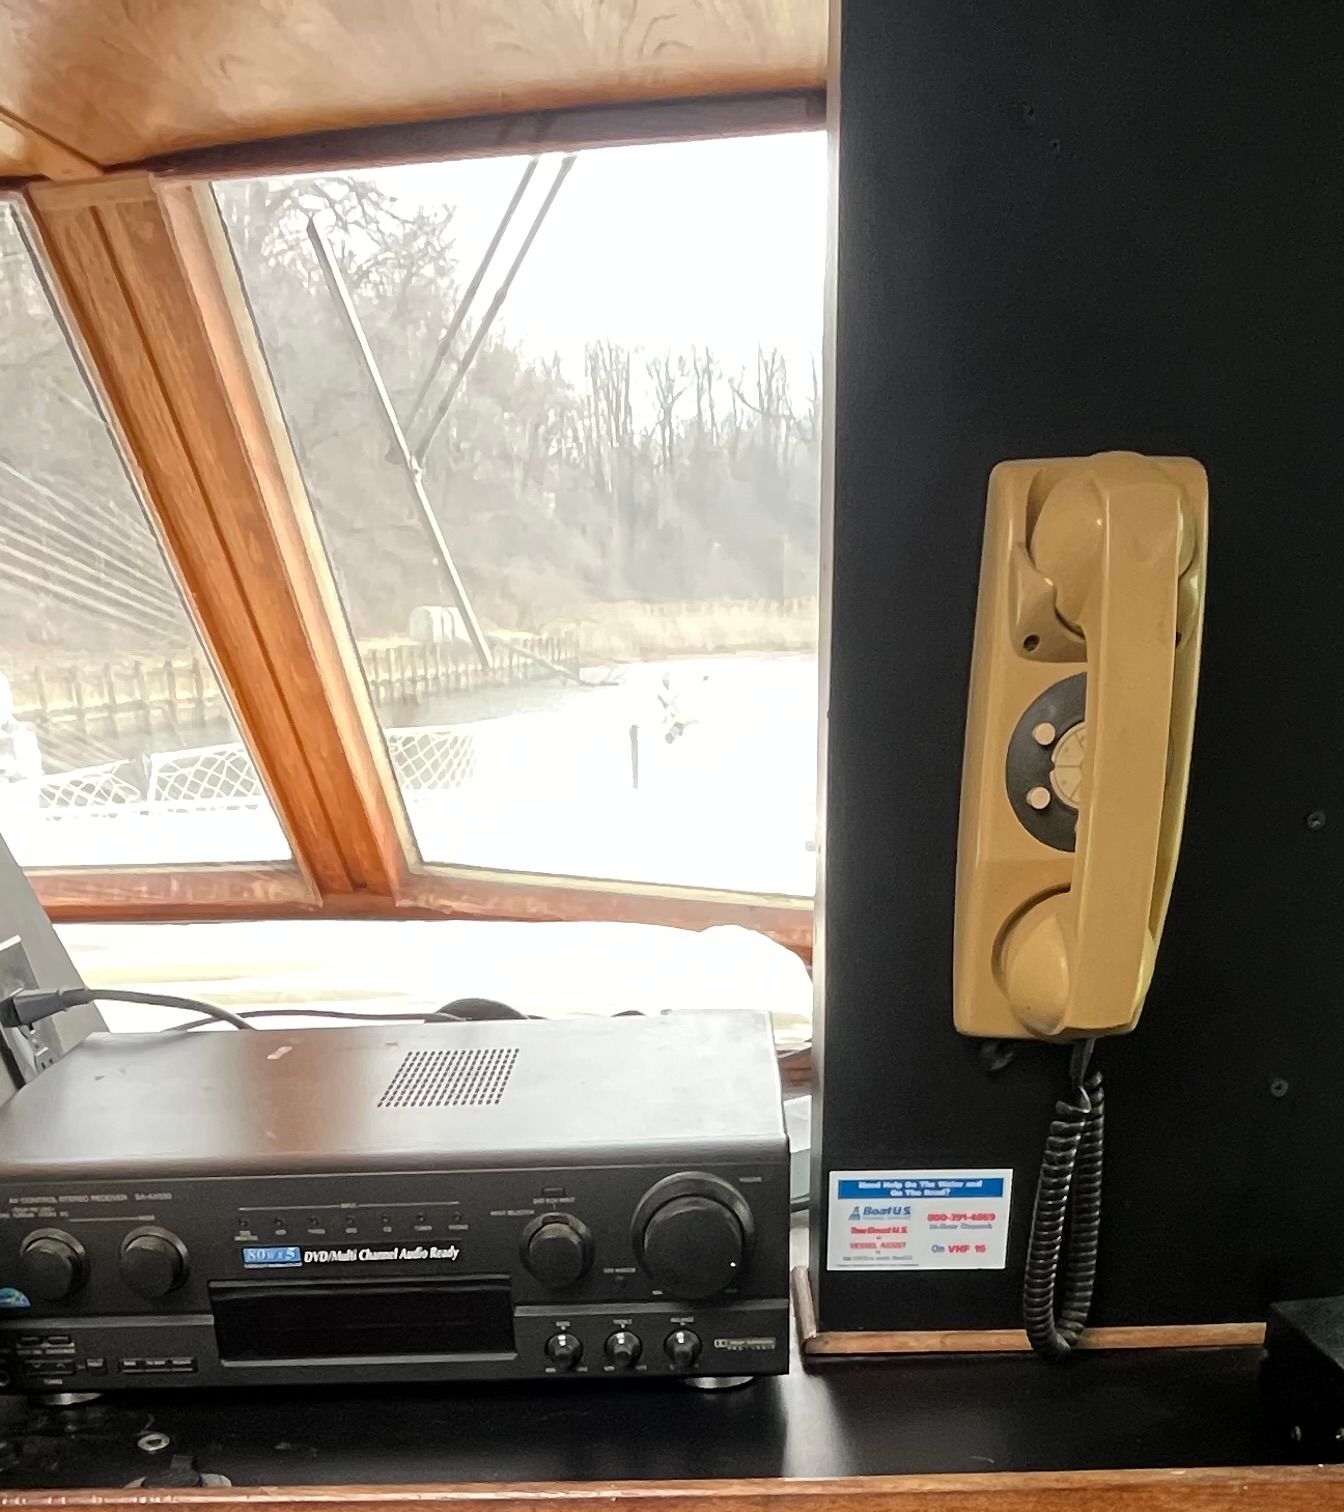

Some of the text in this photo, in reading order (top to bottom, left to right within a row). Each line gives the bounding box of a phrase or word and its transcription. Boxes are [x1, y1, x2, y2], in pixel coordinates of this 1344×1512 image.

[303, 1245, 460, 1263] DVD/Multi Channel Audio Ready
